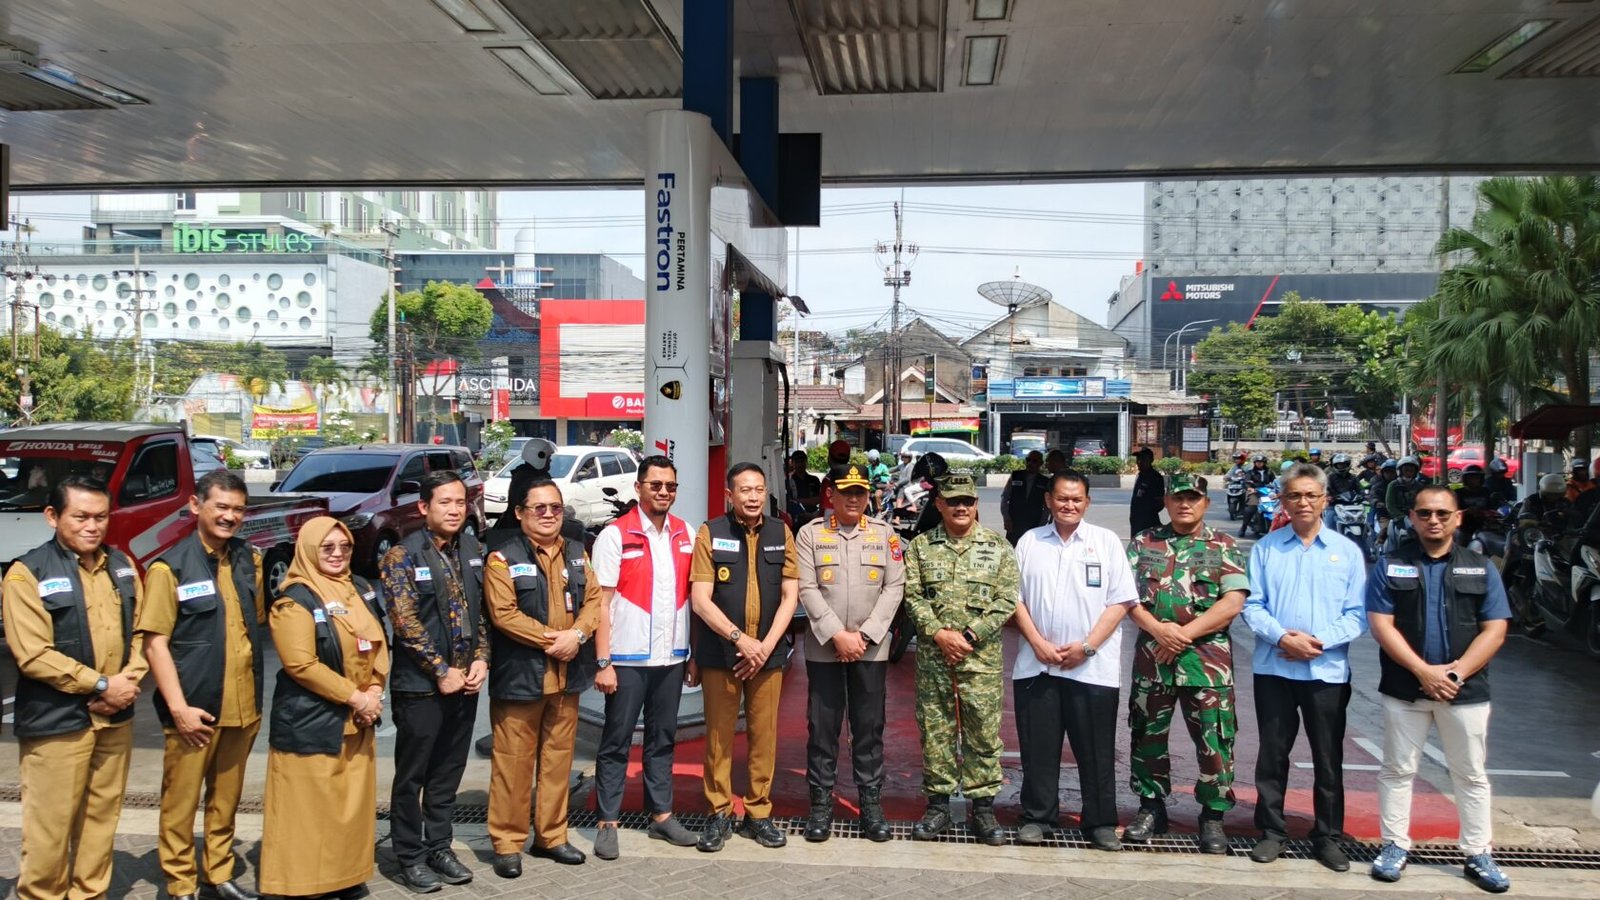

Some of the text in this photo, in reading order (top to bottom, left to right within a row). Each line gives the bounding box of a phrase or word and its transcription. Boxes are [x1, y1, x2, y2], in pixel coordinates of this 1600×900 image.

[173, 221, 227, 253] ibis
[656, 173, 675, 291] Fastron
[677, 231, 685, 291] PERTAMINA
[1185, 284, 1235, 292] MITSUBISHI
[1185, 291, 1222, 300] MOTORS
[458, 377, 536, 392] ASCDA
[23, 441, 75, 451] HONDA
